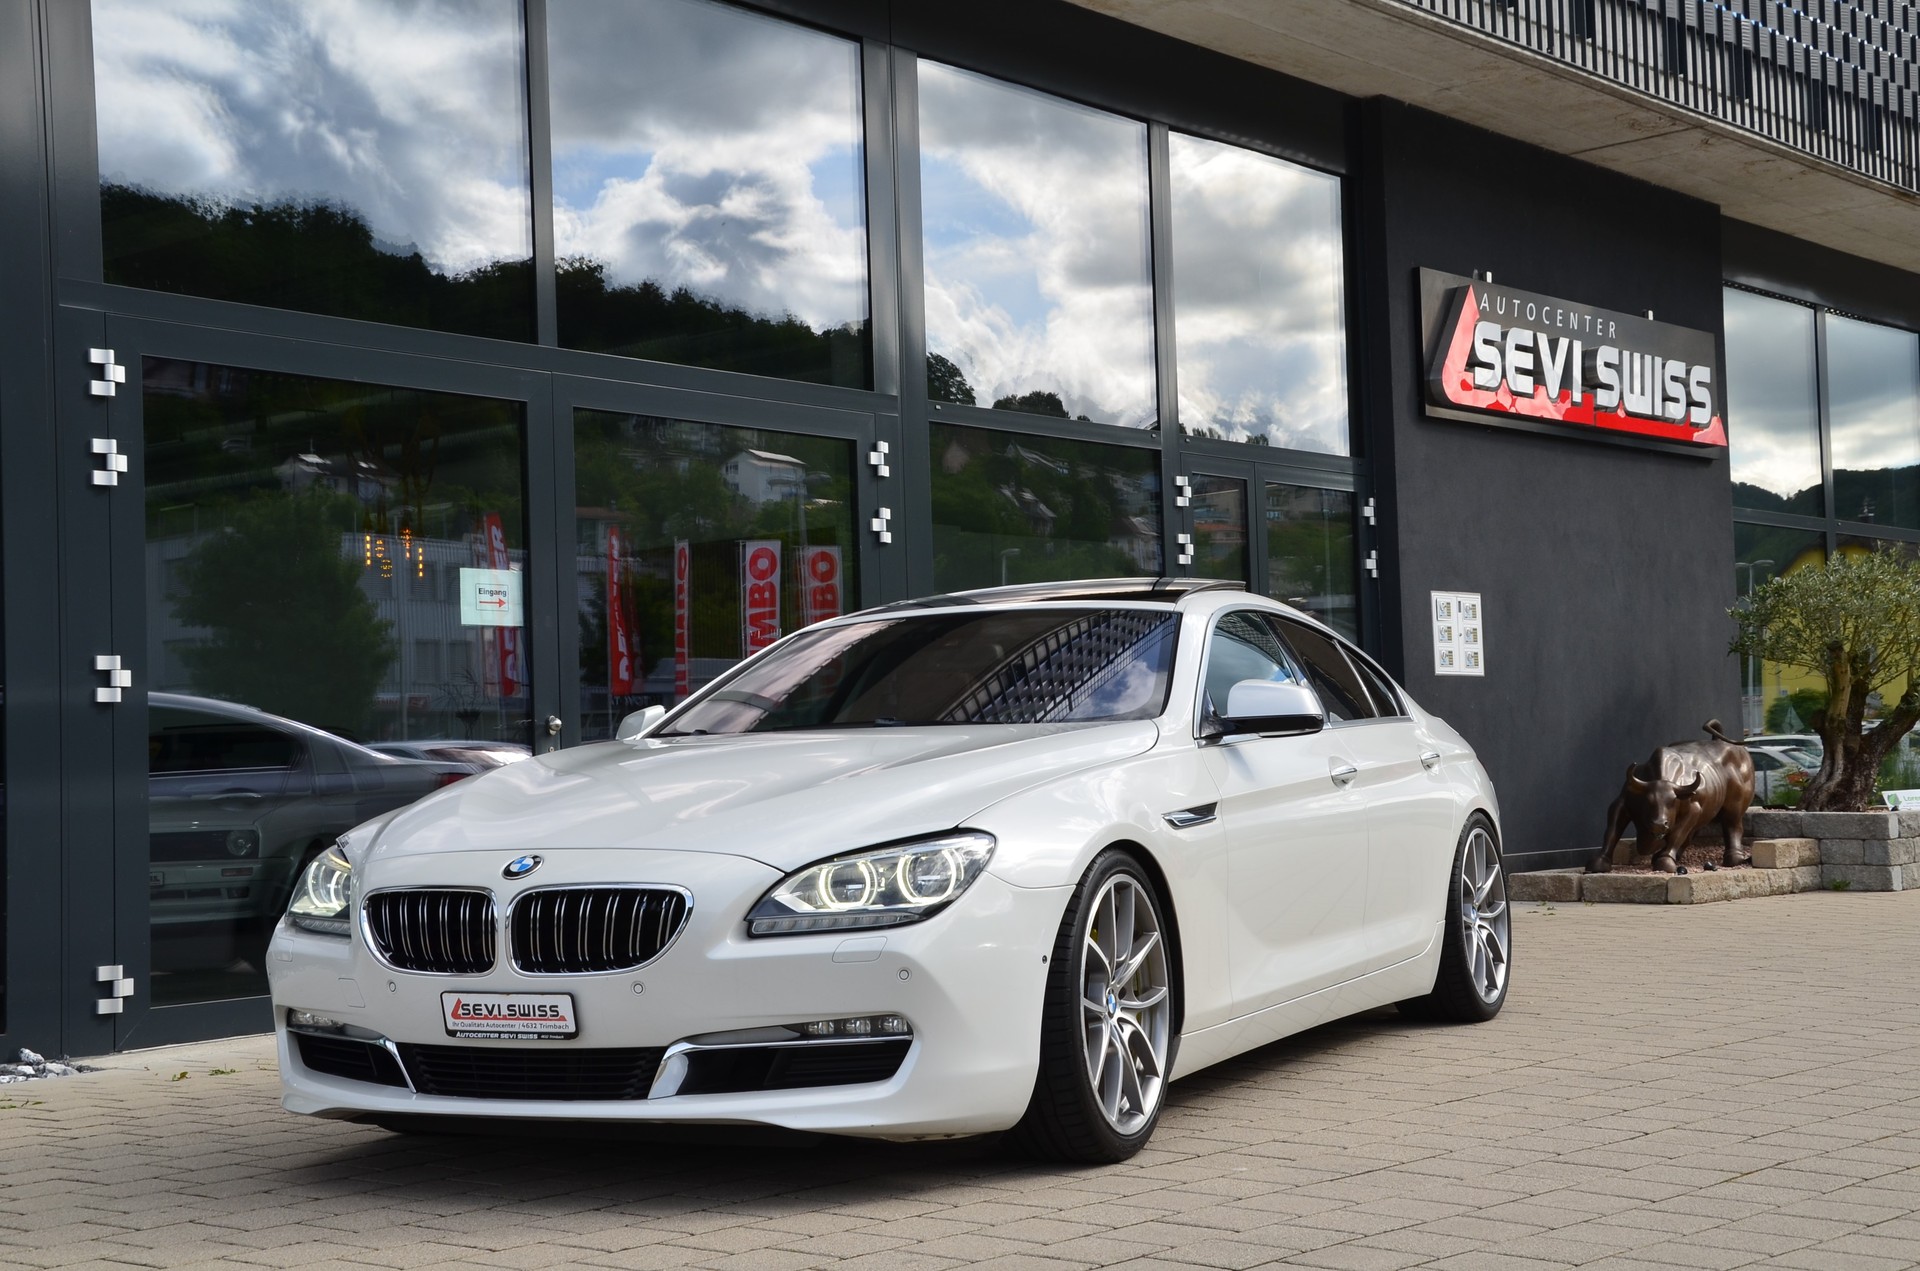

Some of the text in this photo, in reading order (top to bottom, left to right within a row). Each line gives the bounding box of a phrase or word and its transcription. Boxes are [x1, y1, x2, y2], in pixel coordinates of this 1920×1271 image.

[1480, 292, 1617, 339] AUTOCENTER
[1474, 321, 1712, 425] SEVI SWISS
[478, 588, 507, 598] Eingang
[748, 547, 778, 657] MBO
[461, 1003, 560, 1018] SEVI SWISS
